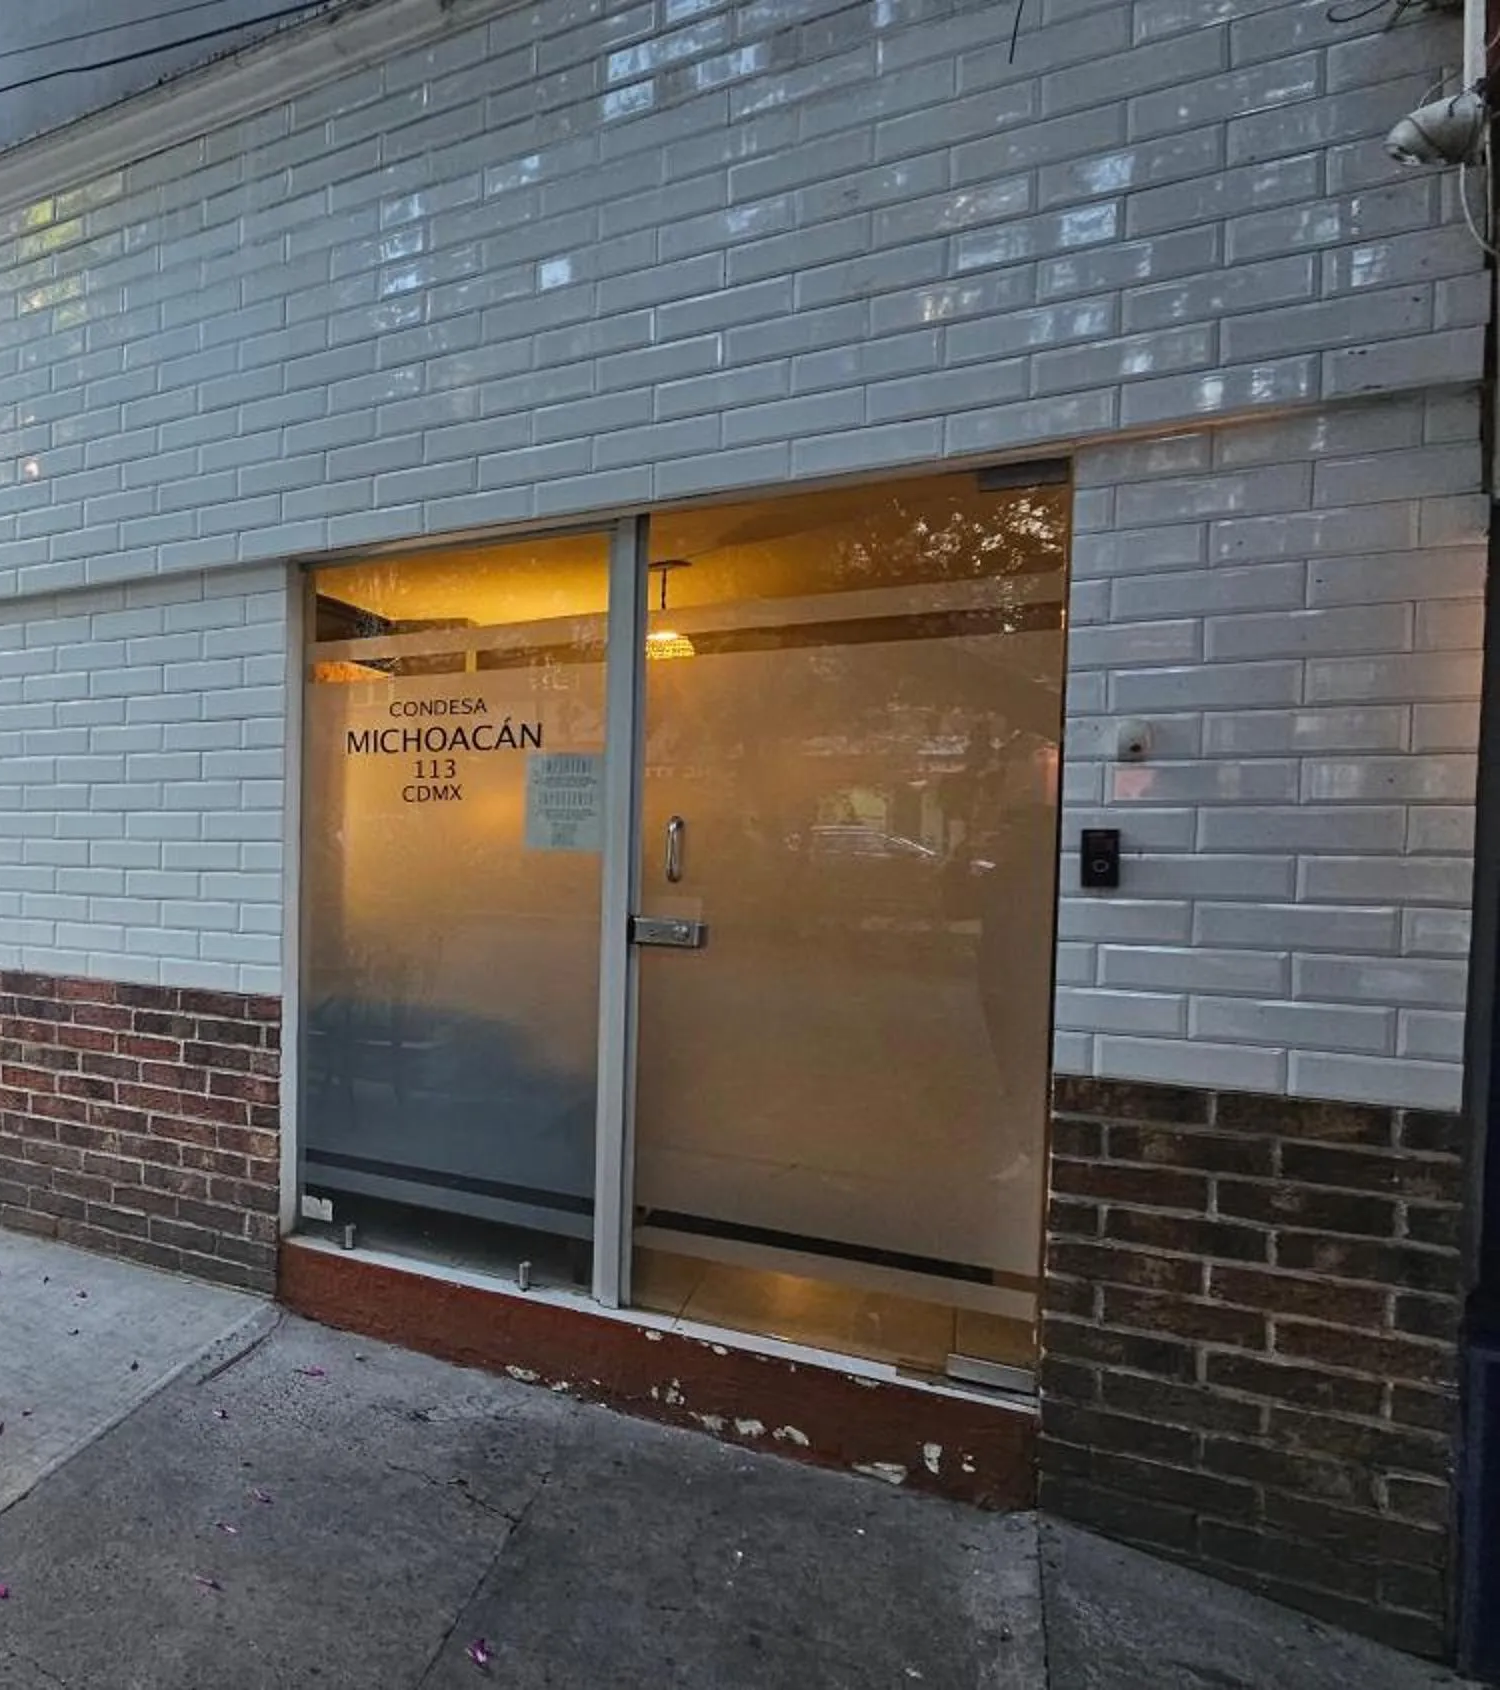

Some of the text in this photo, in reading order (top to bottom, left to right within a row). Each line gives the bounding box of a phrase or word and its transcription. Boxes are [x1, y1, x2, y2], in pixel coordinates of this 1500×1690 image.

[389, 698, 487, 718] CONDESA
[347, 716, 543, 755] MICHOACÁN
[414, 759, 457, 779] 113
[402, 783, 464, 803] CDMX
